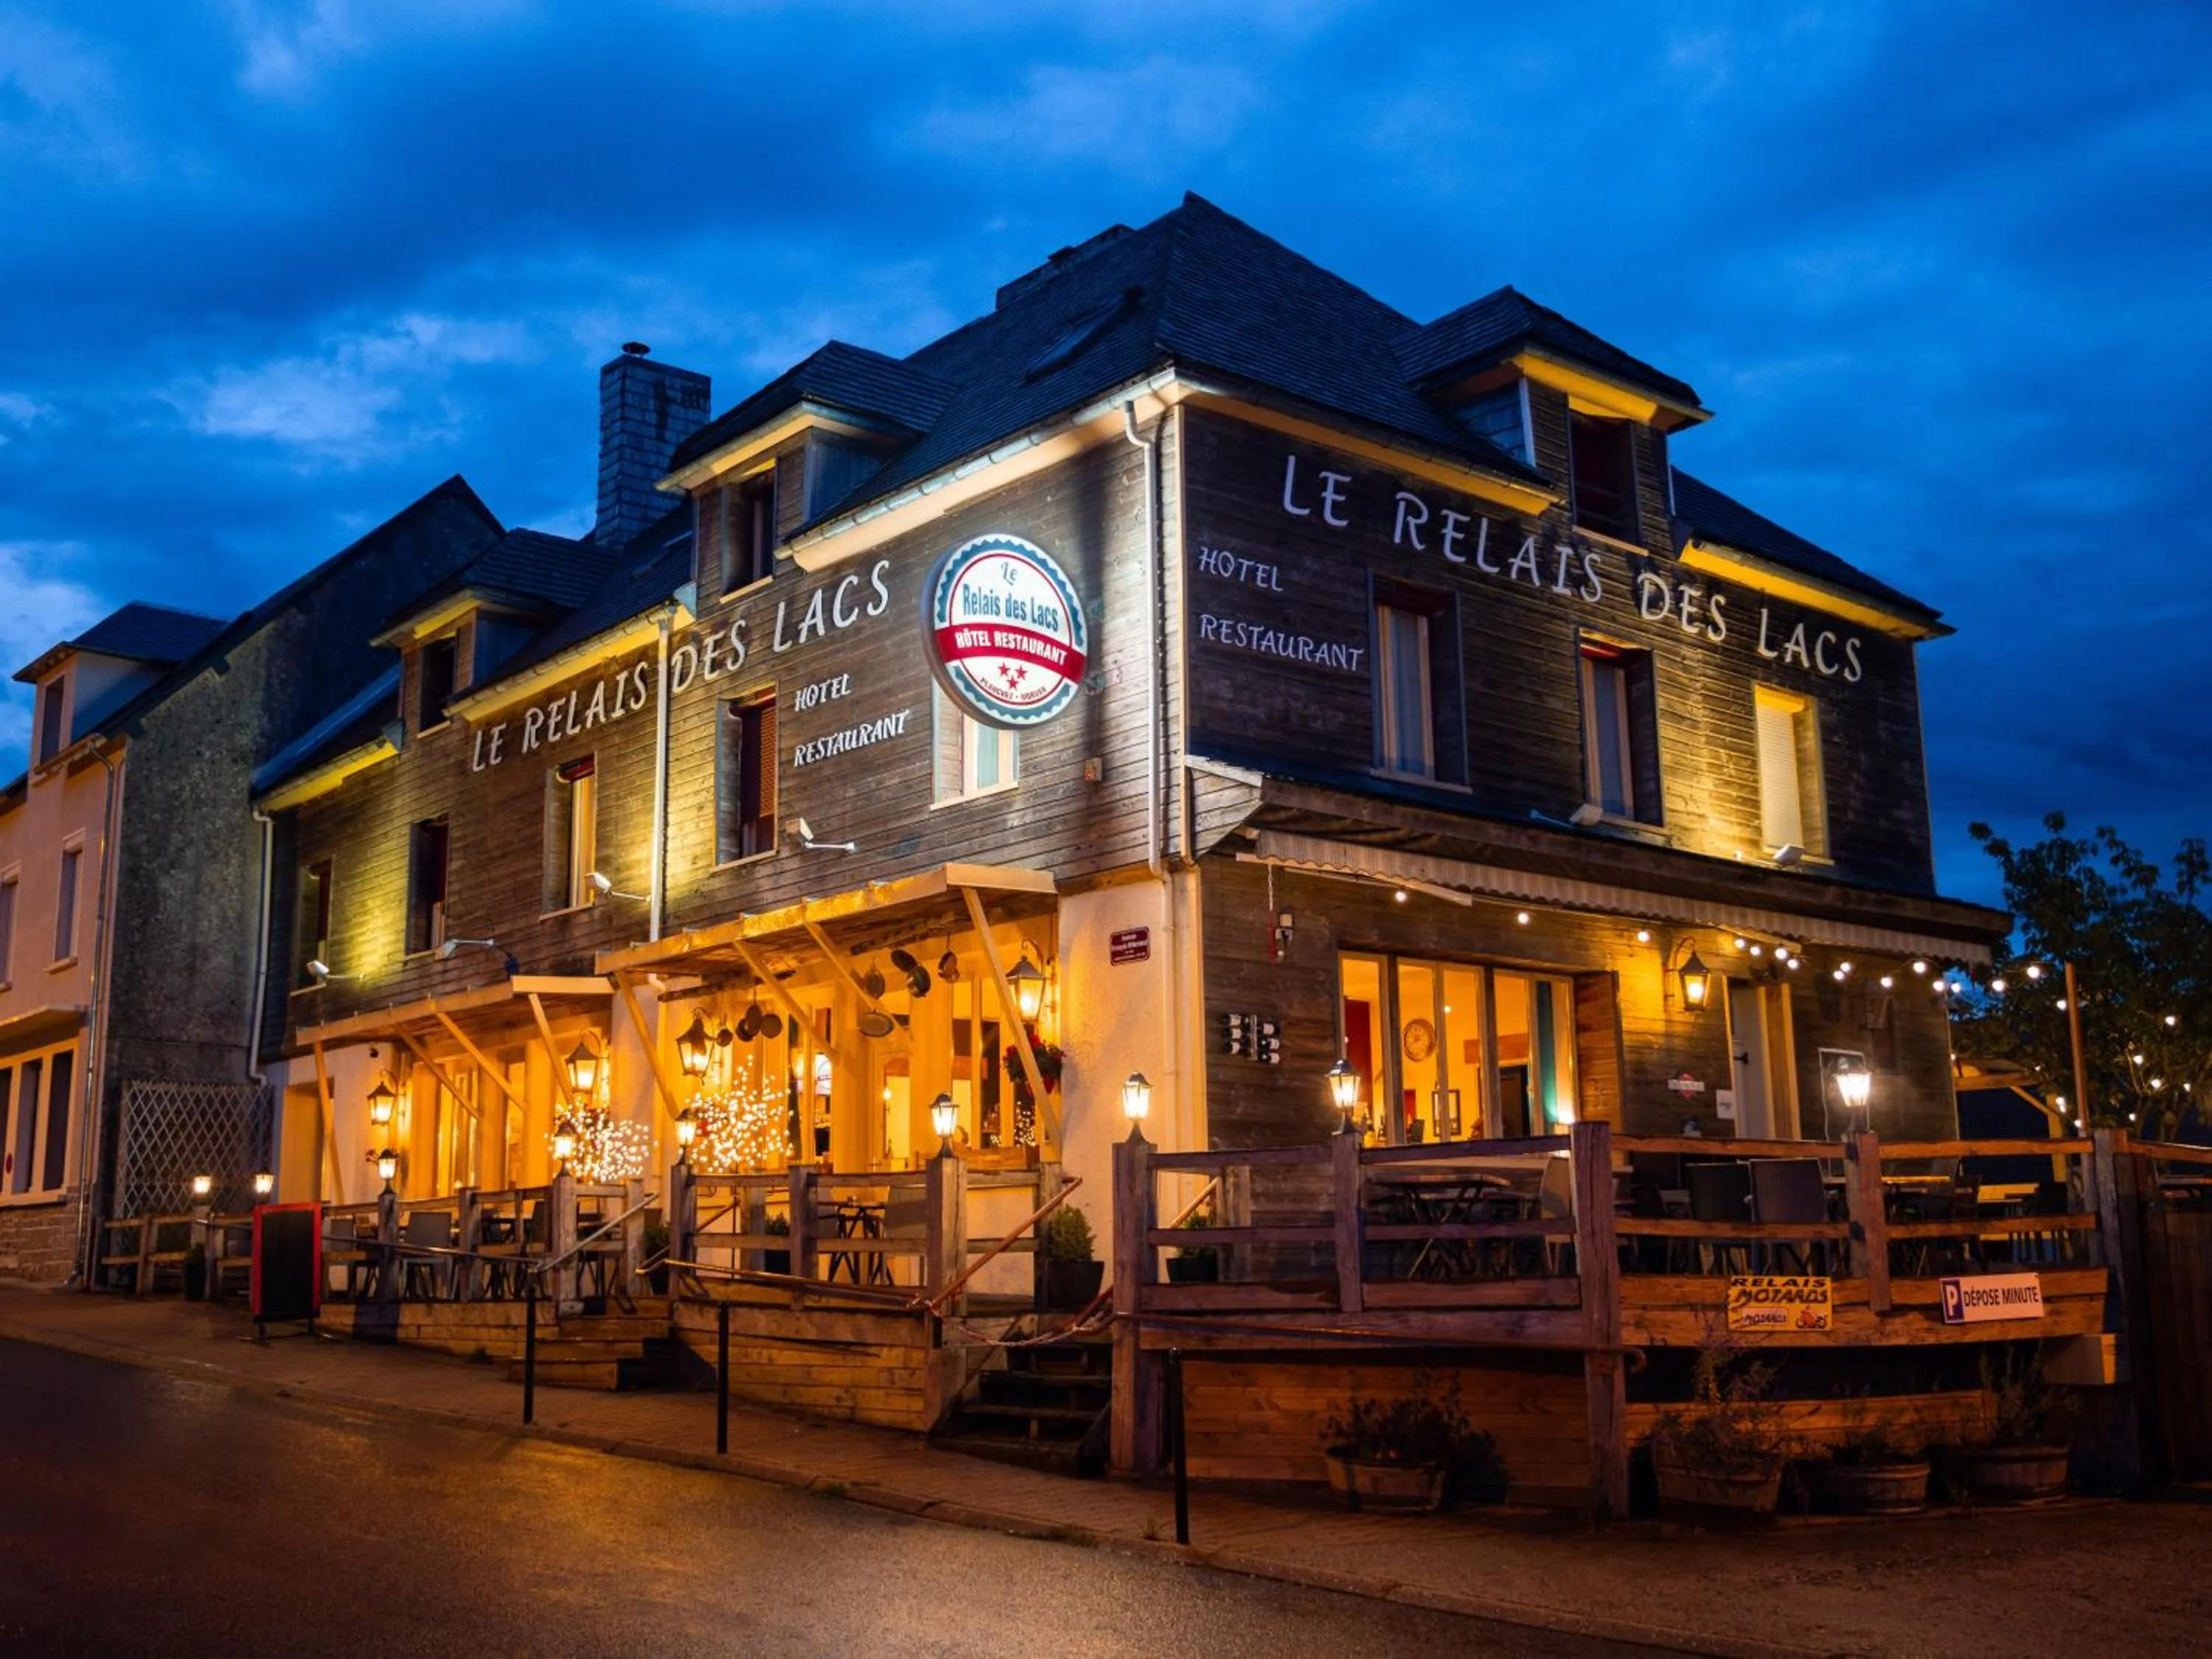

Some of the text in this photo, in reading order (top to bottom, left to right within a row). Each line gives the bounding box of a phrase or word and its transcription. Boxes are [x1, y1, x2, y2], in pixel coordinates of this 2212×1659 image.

[1001, 561, 1018, 586] Le
[1197, 545, 1284, 592] HOTEL
[1281, 453, 1863, 683] LE RELAIS DES LACS
[962, 583, 1059, 632] Relais des Lacs
[955, 627, 1068, 666] HÔTEL RESTAURANT
[1198, 613, 1365, 672] RESTAURANT
[472, 559, 890, 773] LE RELAIS DES LACS
[795, 672, 852, 712] HOTEL
[793, 709, 910, 768] RESTAURANT
[1731, 1278, 1827, 1287] RELAIS
[1731, 1287, 1828, 1310] MOTARDS
[1945, 1284, 2039, 1316] P DÉPOSE MINUTE
